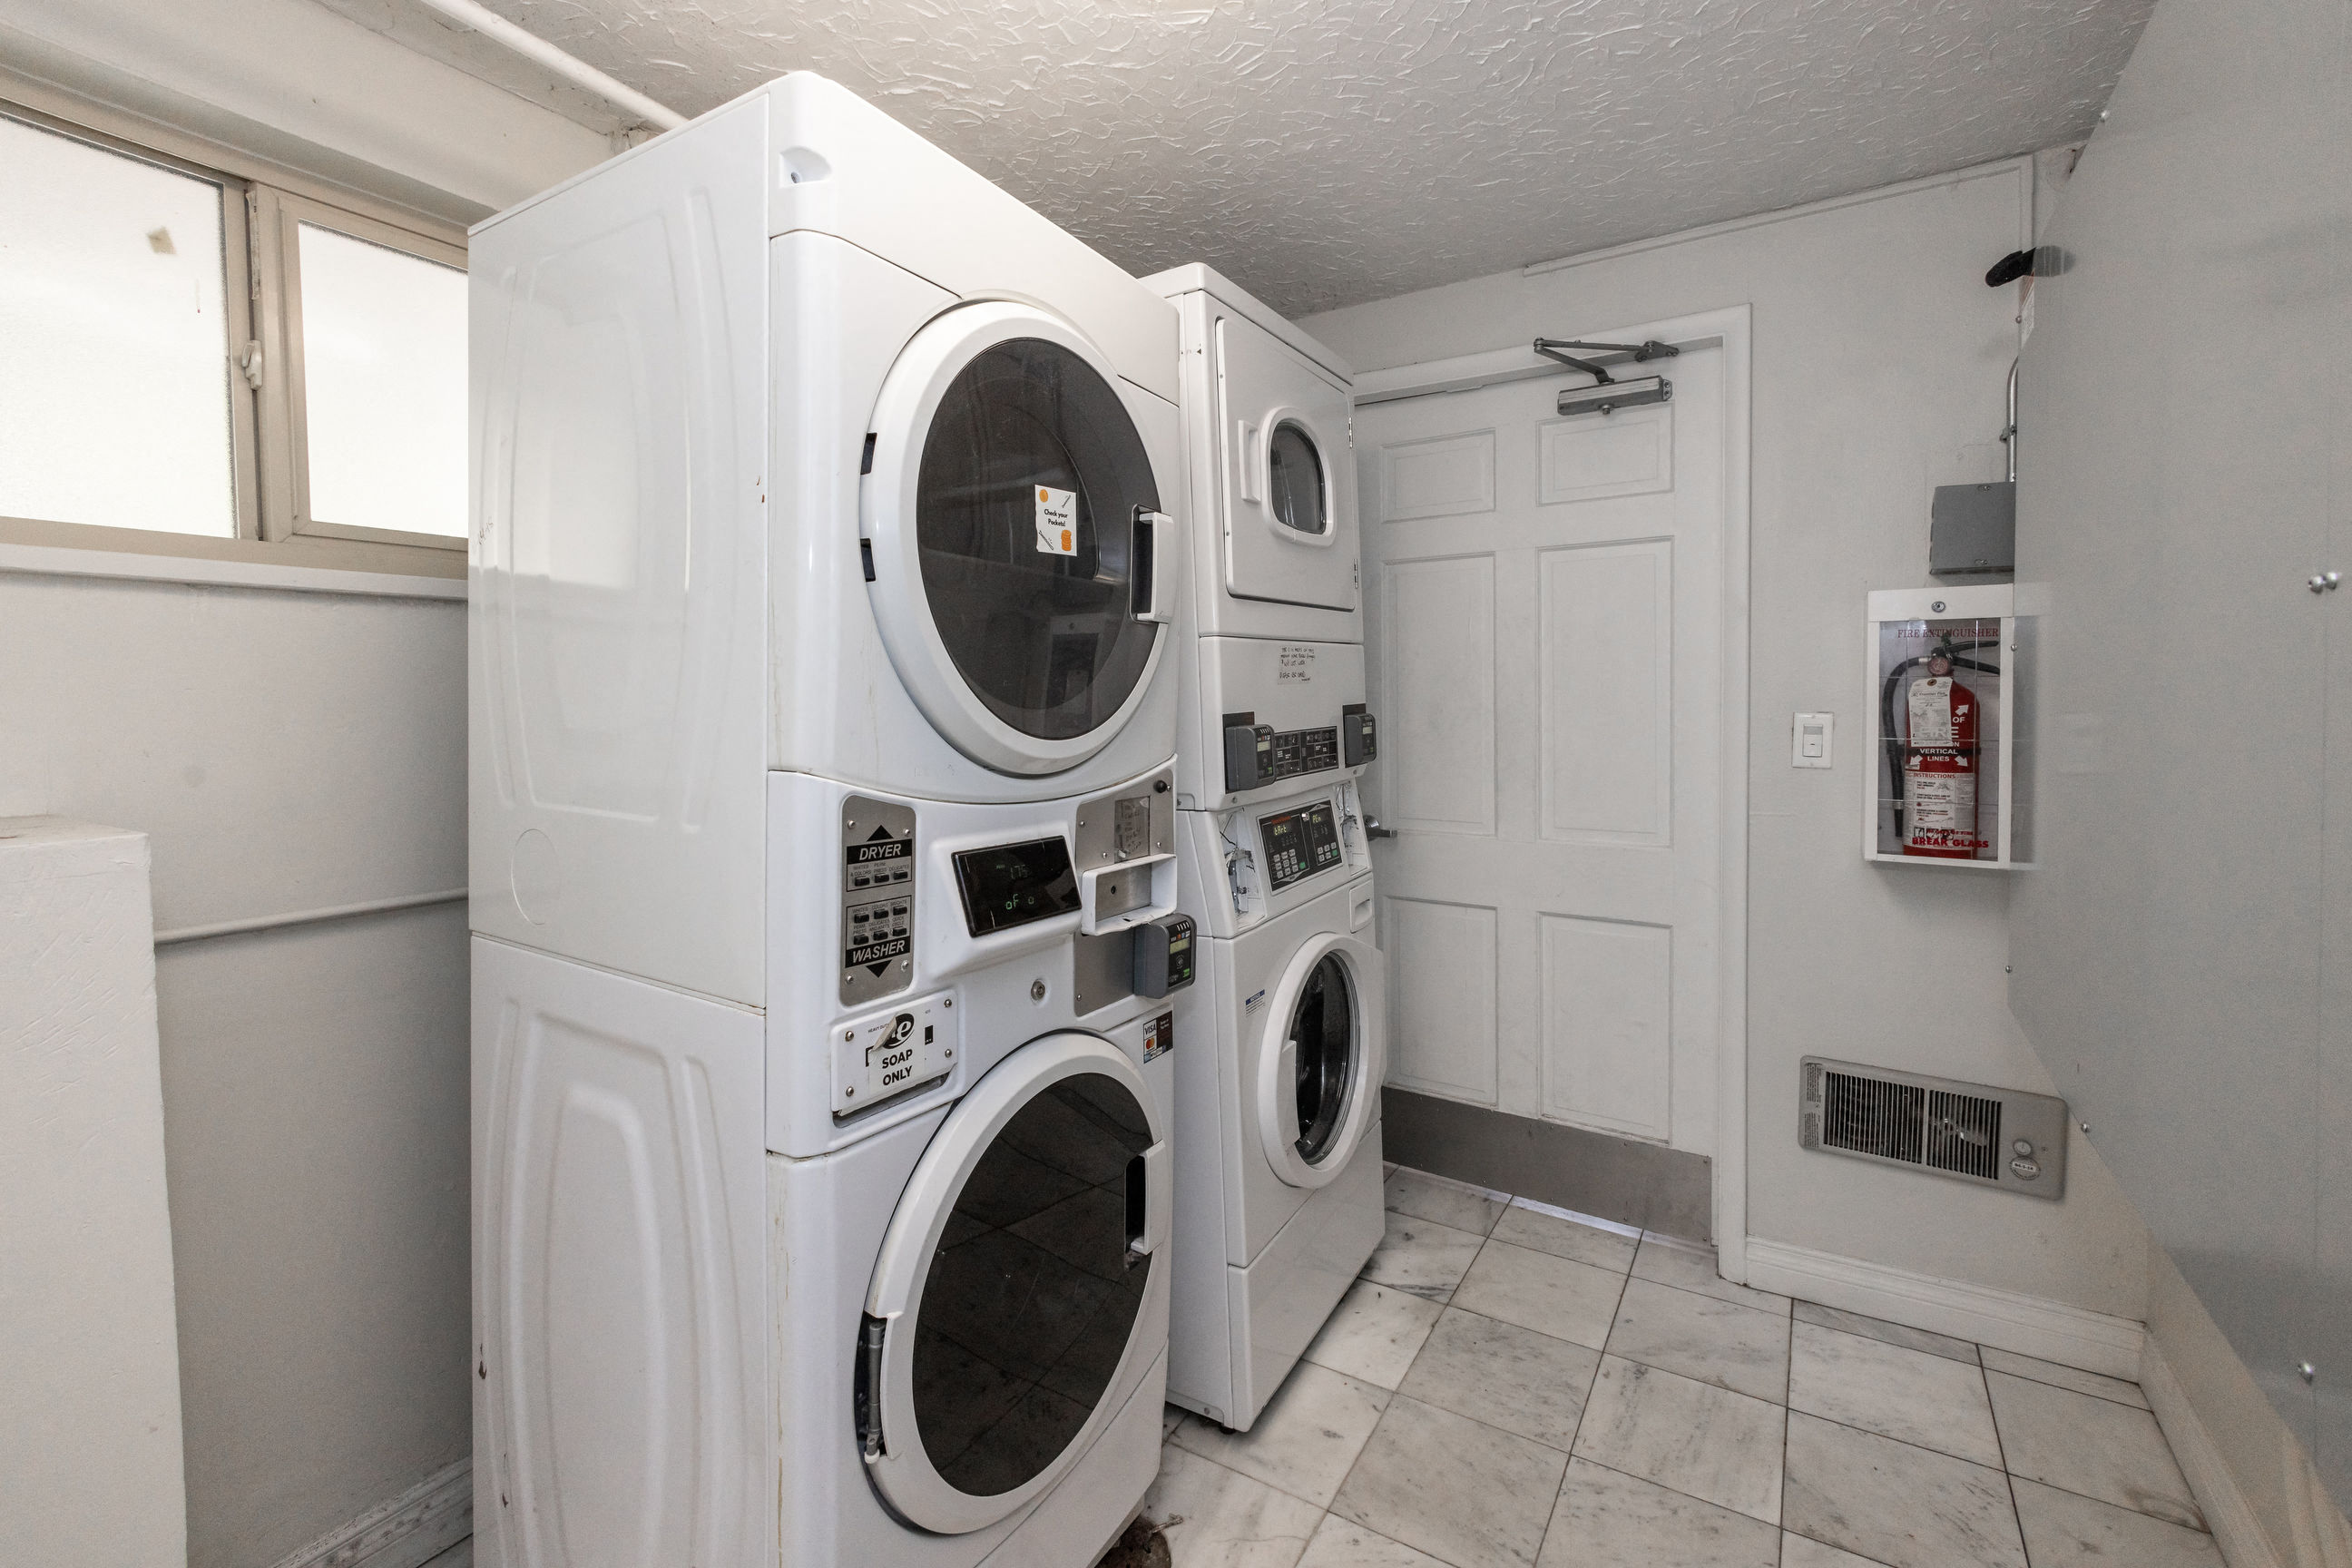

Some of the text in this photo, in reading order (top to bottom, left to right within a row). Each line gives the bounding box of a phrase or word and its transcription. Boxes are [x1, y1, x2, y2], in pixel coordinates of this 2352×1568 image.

[1044, 508, 1057, 517] Check
[1048, 518, 1066, 527] Pockets!
[1897, 628, 1999, 639] FIRE EXTINGUISHER
[1912, 837, 1989, 848] BREAK GLASS
[859, 844, 902, 861] DRYER
[853, 940, 906, 964] WASHER
[1145, 1024, 1157, 1035] VISA
[882, 1049, 913, 1069] SOAP
[883, 1065, 913, 1086] ONLY
